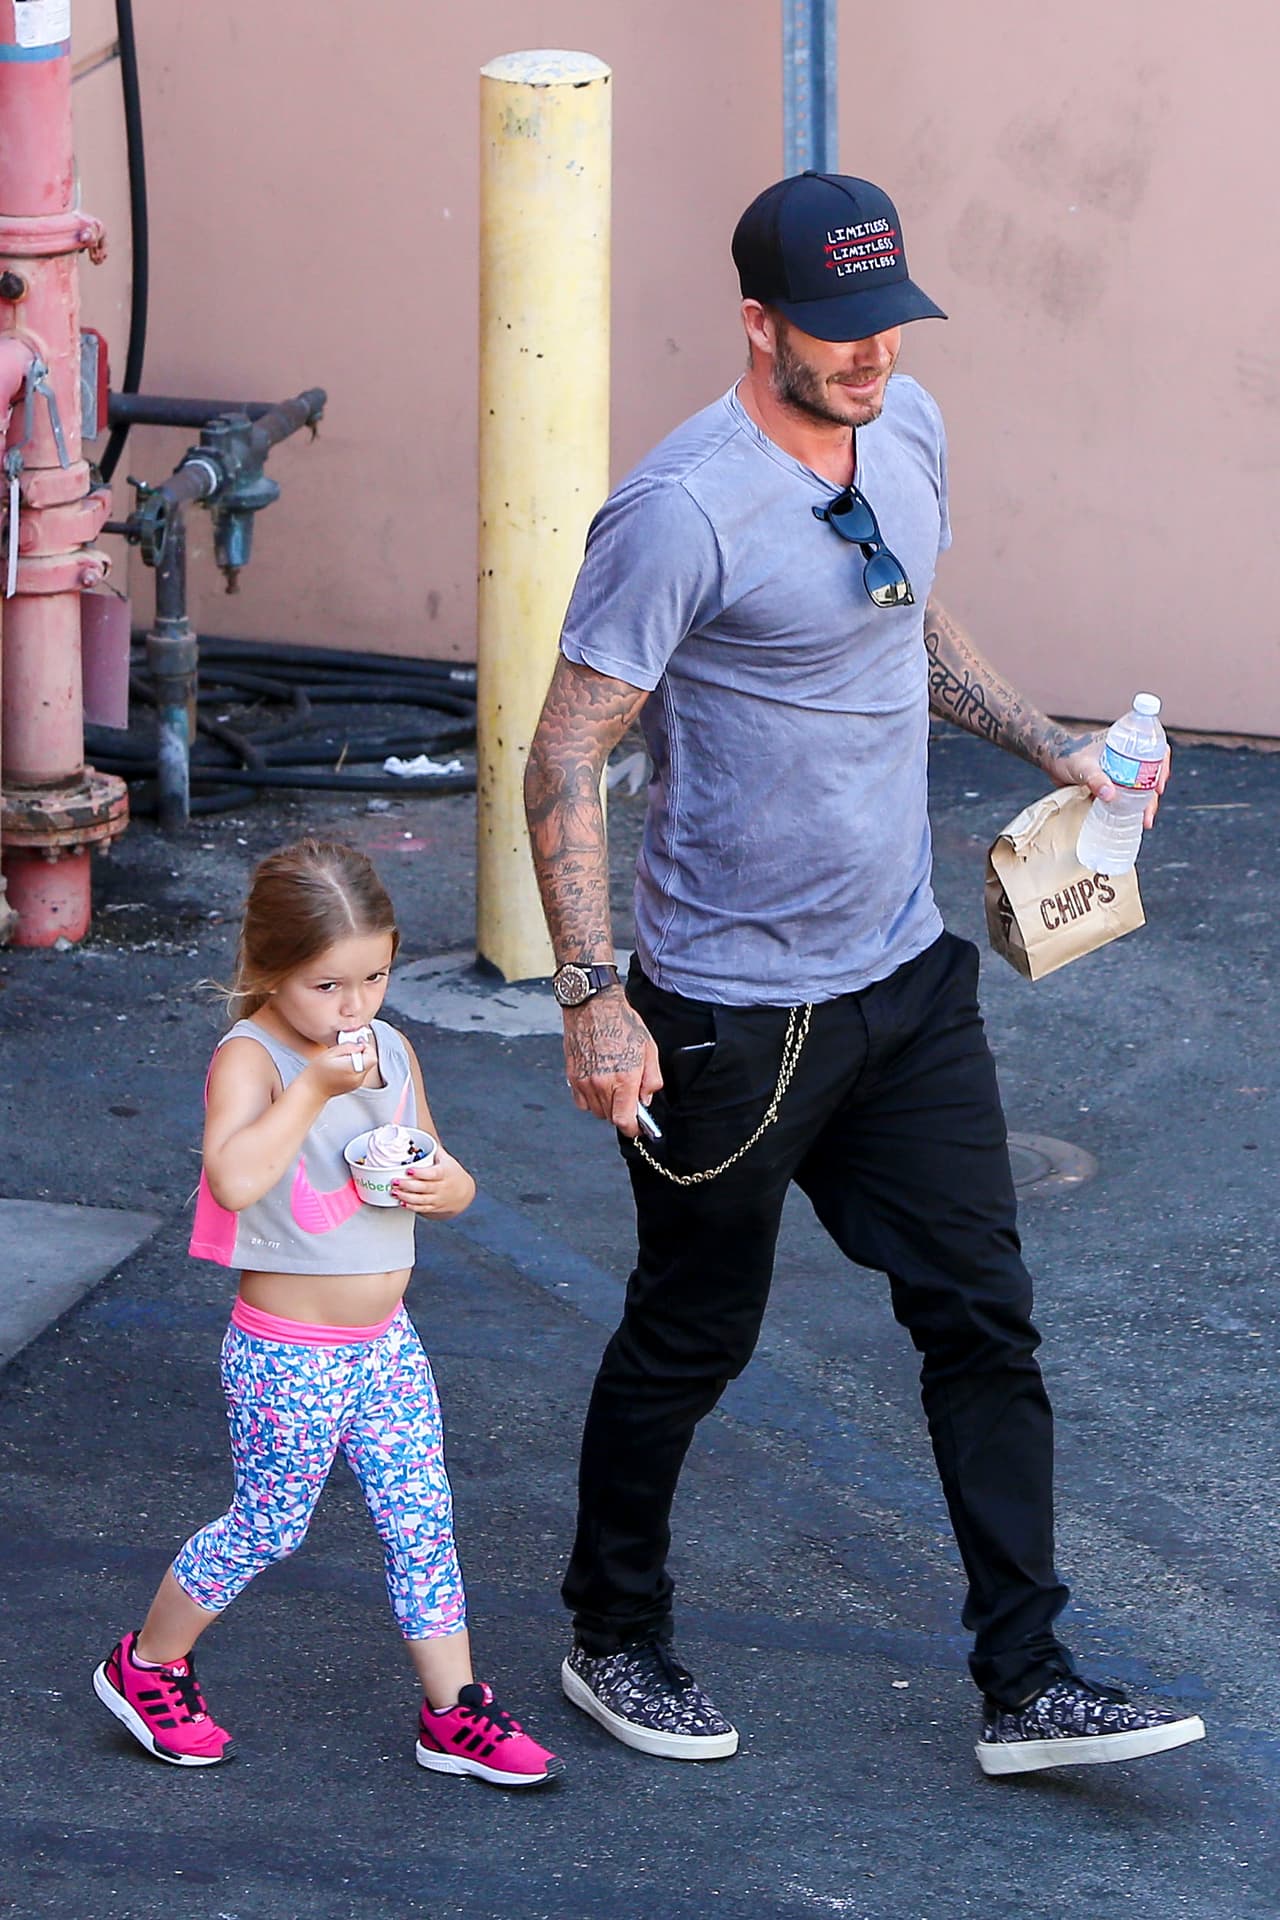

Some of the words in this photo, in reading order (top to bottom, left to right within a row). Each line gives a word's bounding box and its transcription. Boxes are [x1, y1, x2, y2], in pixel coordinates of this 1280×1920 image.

[827, 218, 889, 244] LIMITLESS
[833, 237, 894, 260] LIMITLESS
[837, 255, 896, 277] LIMITLESS
[1040, 872, 1116, 930] CHIPS
